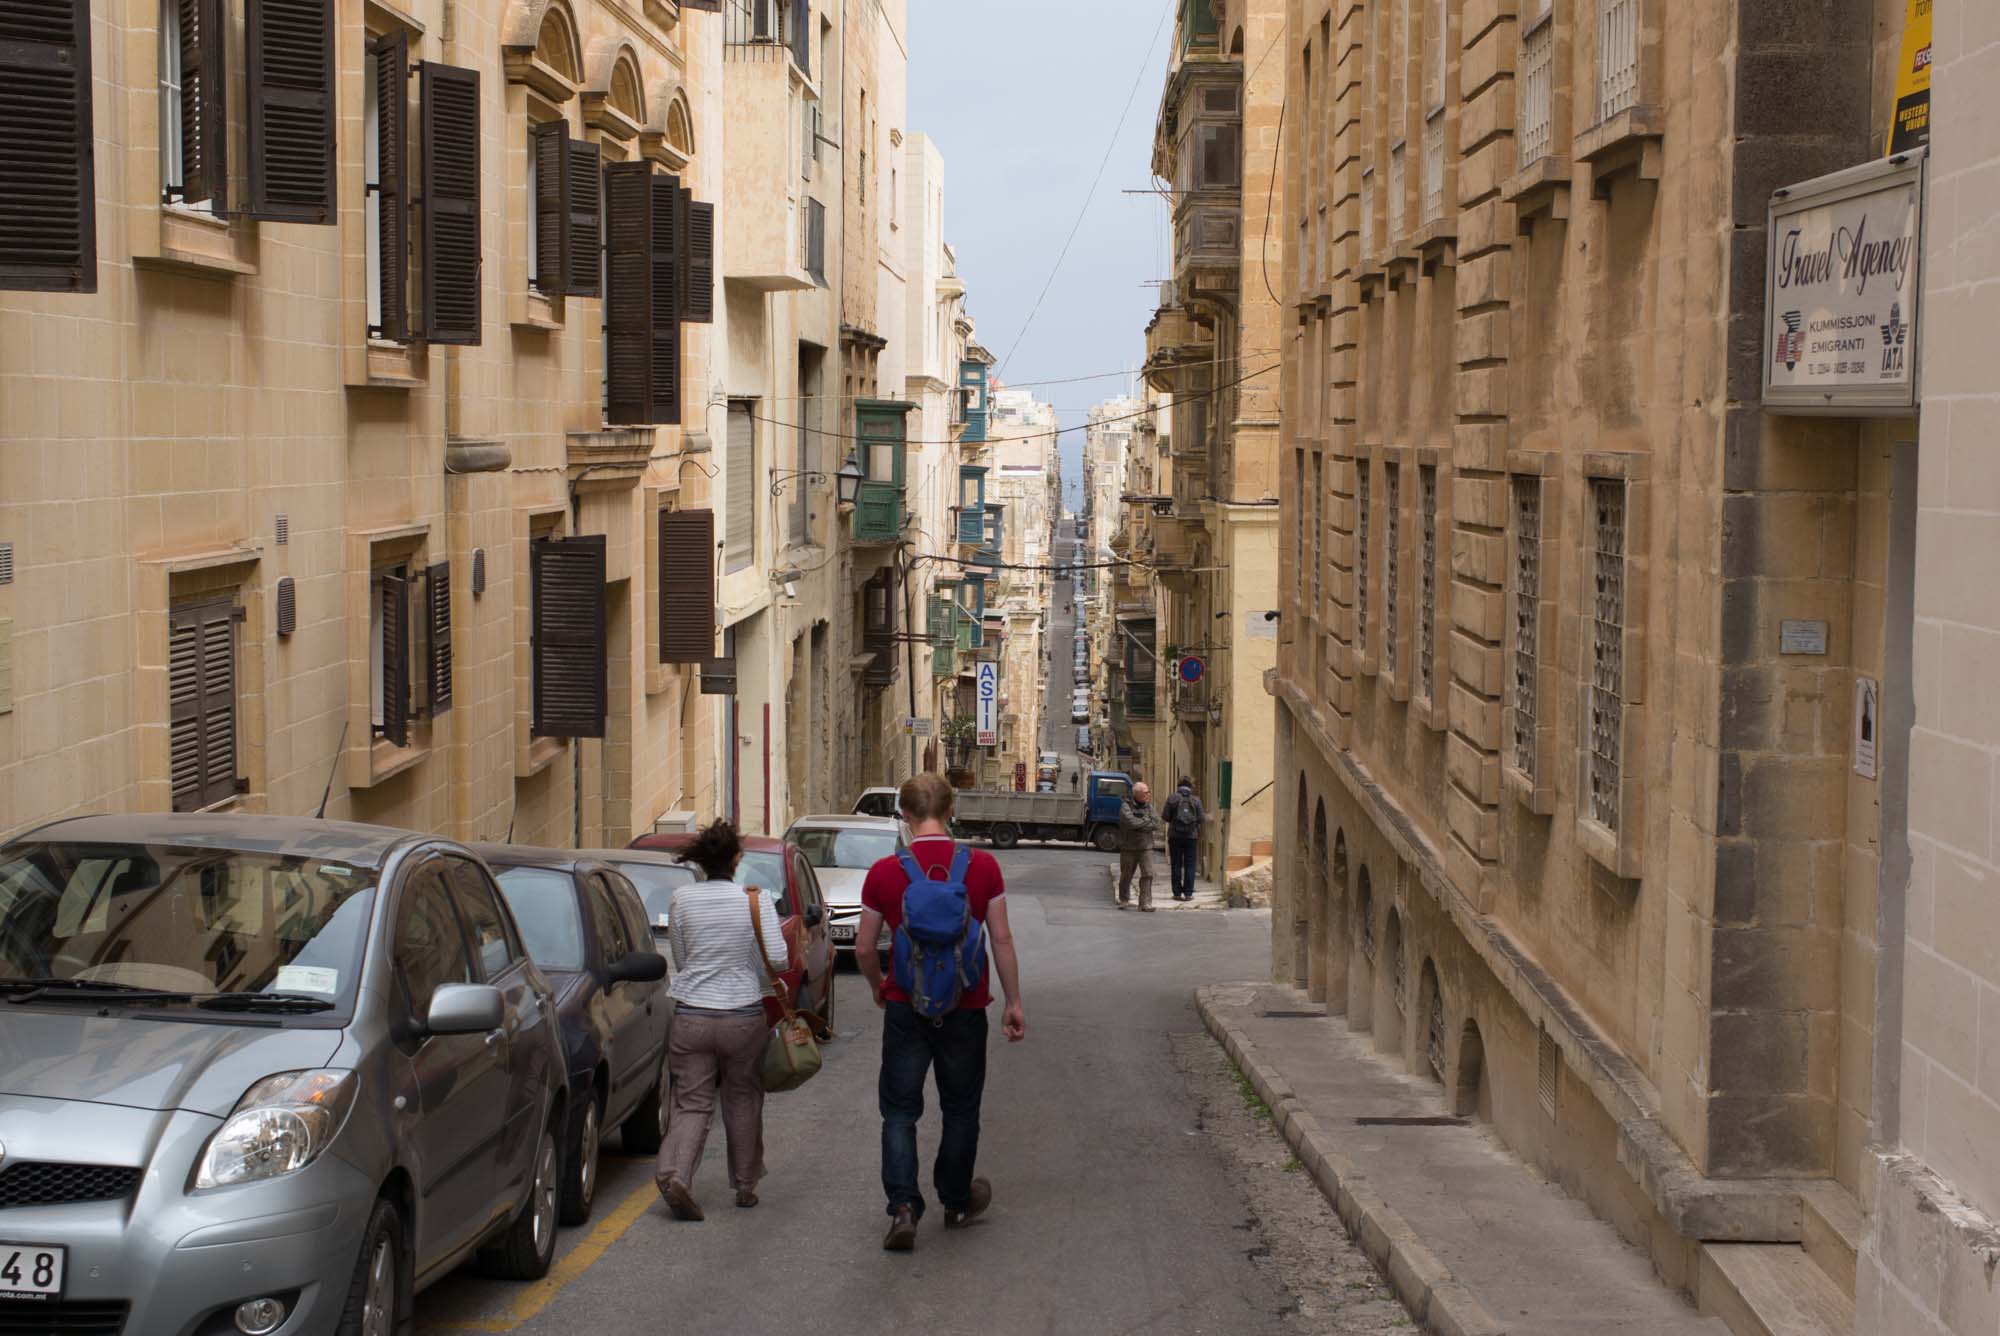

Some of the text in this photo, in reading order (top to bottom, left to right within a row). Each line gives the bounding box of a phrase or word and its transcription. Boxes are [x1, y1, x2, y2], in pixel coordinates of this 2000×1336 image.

[1899, 103, 1928, 122] WESTERN
[1905, 115, 1928, 132] UNION
[1778, 213, 1913, 296] Travel Agency
[1809, 314, 1876, 333] KUMMISSJONI
[1811, 338, 1865, 353] EMIGRANTI
[1881, 347, 1904, 371] IATA
[980, 664, 995, 730] ASTI
[831, 927, 850, 937] 635
[1, 1251, 54, 1288] 48
